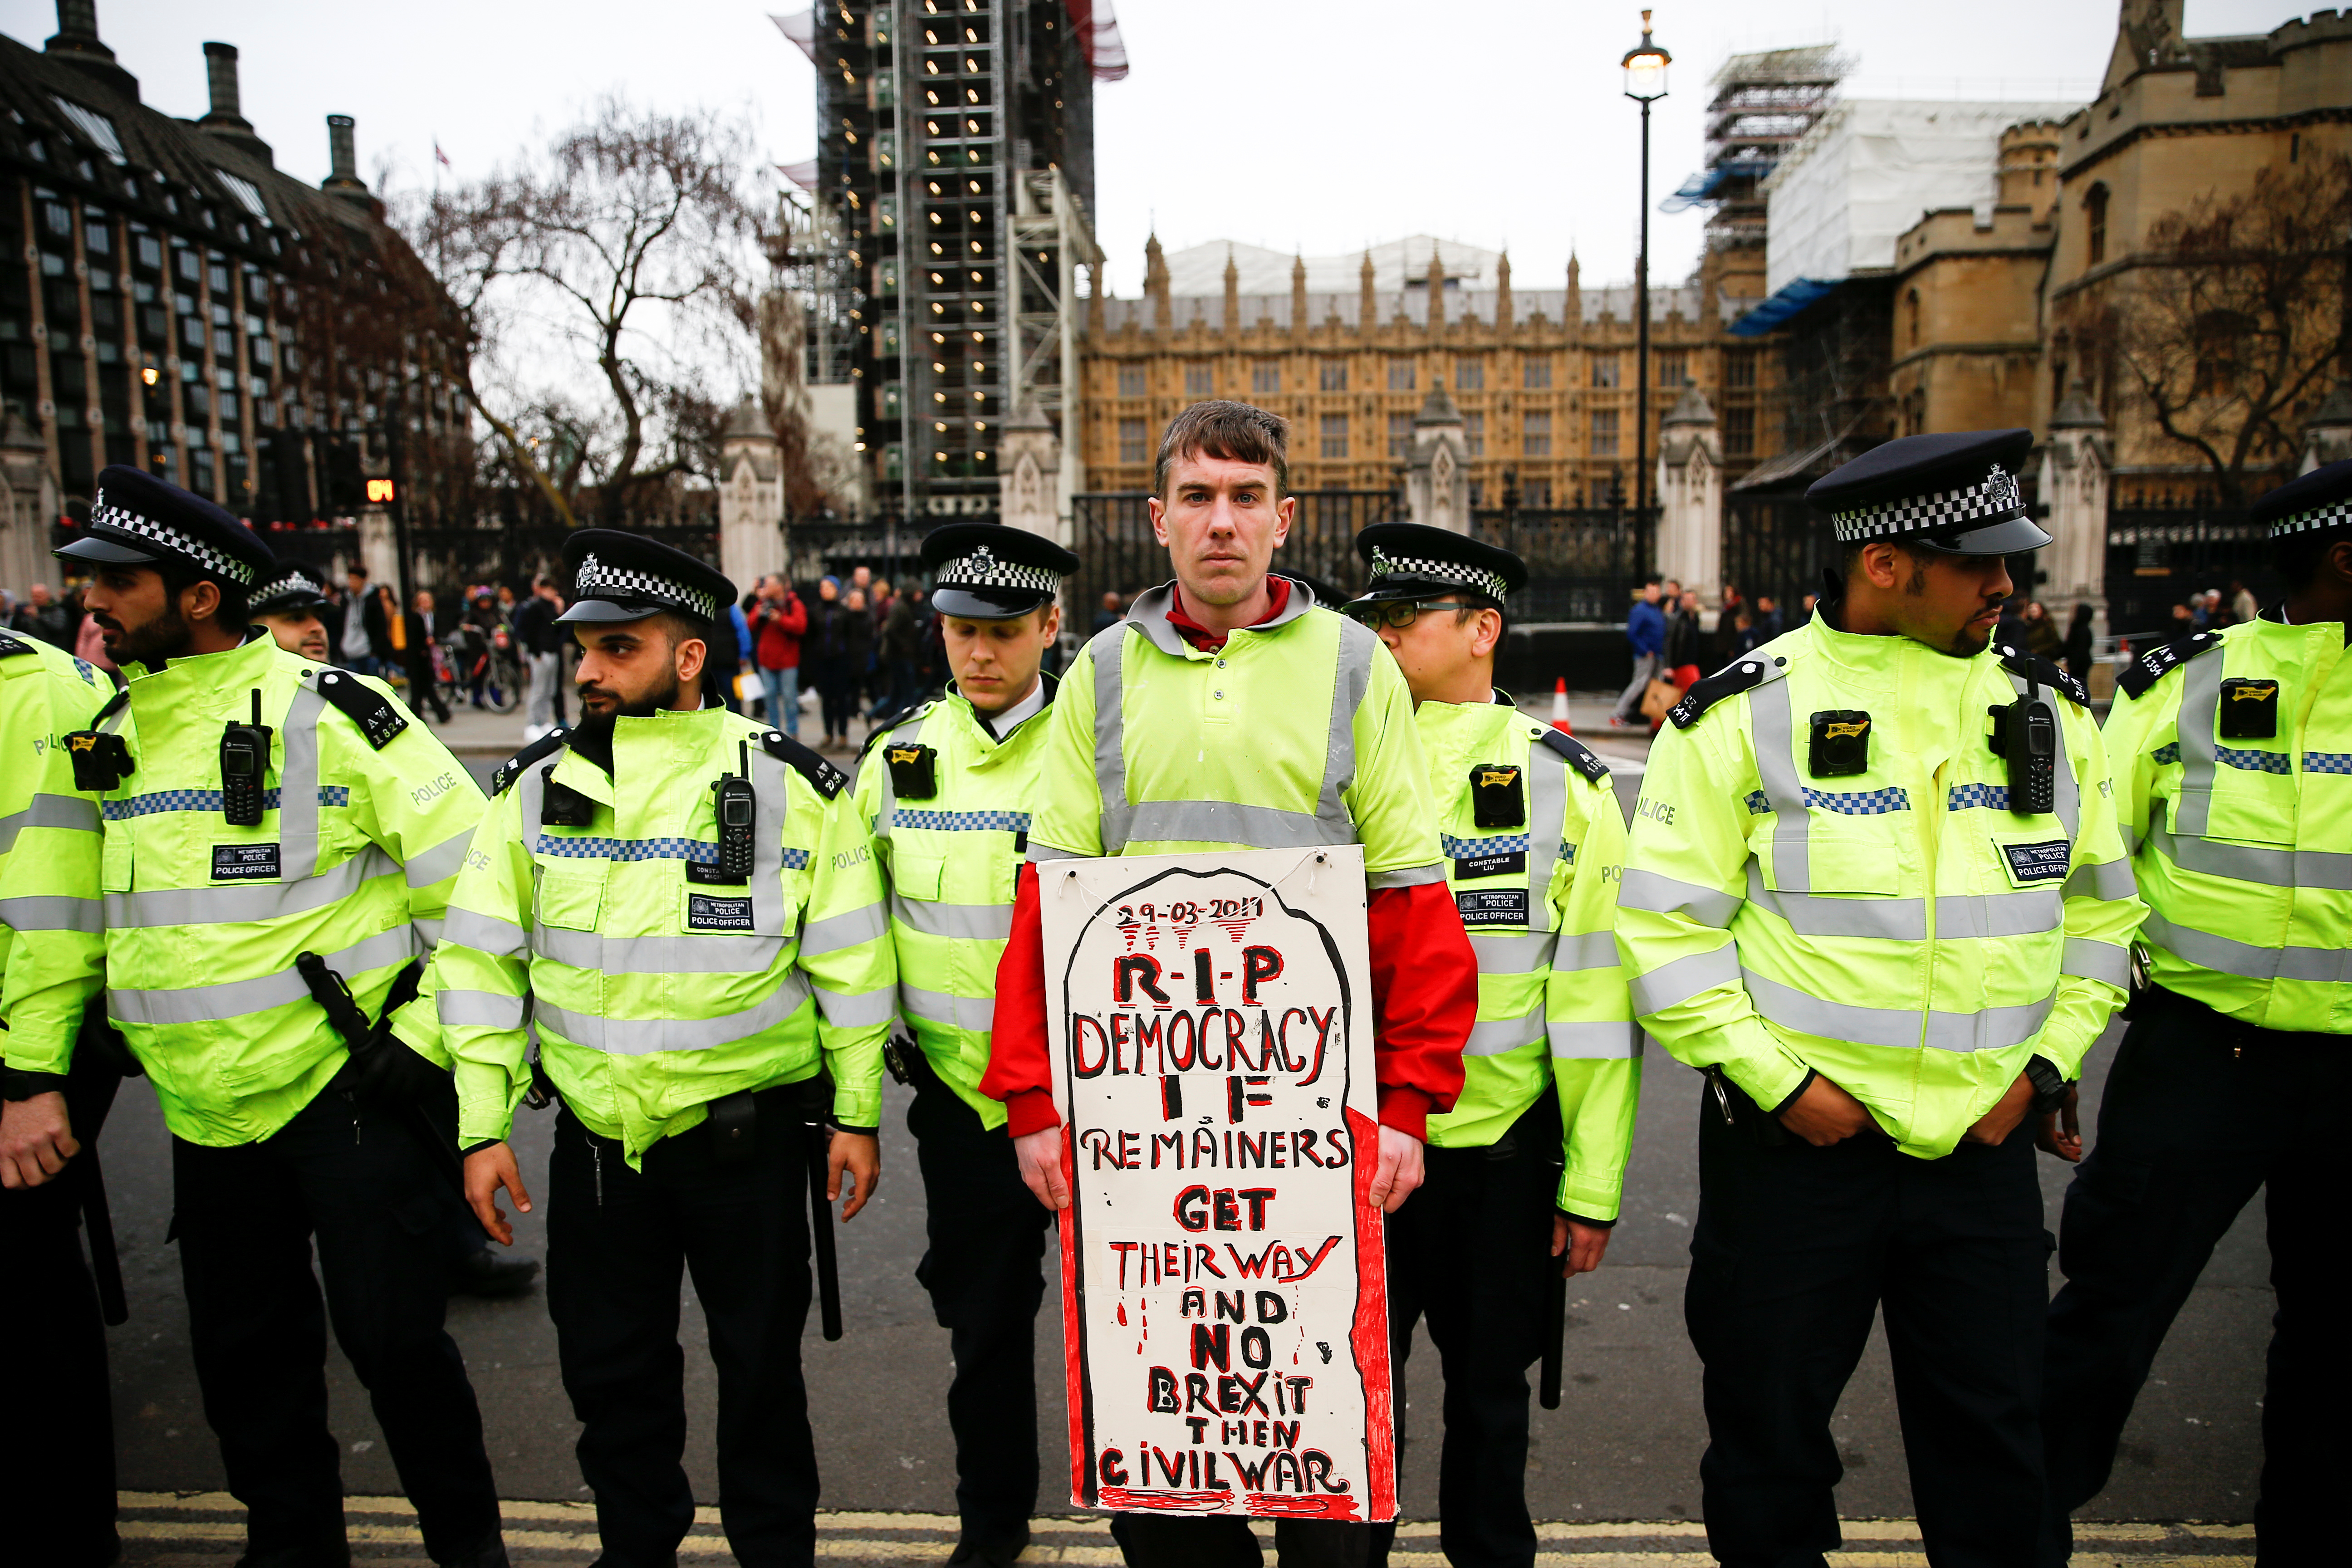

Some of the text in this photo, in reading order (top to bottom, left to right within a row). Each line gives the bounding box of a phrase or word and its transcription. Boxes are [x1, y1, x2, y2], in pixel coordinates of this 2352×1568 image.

[368, 706, 387, 729] AW
[373, 717, 402, 744] 1824
[411, 772, 457, 806] POLICE
[1637, 796, 1675, 825] LICE
[1469, 857, 1510, 867] CONSTABLE
[2018, 864, 2068, 876] POLICE OFFIC
[2038, 852, 2066, 860] POLICE
[692, 916, 718, 925] POLICE
[1460, 912, 1524, 920] POLICE OFFICER
[1073, 1006, 1337, 1087] DEMOCRACY
[1158, 1075, 1272, 1124] IF
[1080, 1128, 1349, 1170] REMAINERS
[1173, 1184, 1276, 1231] GET
[1225, 1235, 1343, 1284] WAY
[1180, 1287, 1288, 1324] AND
[1191, 1323, 1271, 1373] NO
[1186, 1416, 1300, 1449] THEN
[1223, 1448, 1350, 1494] WAR
